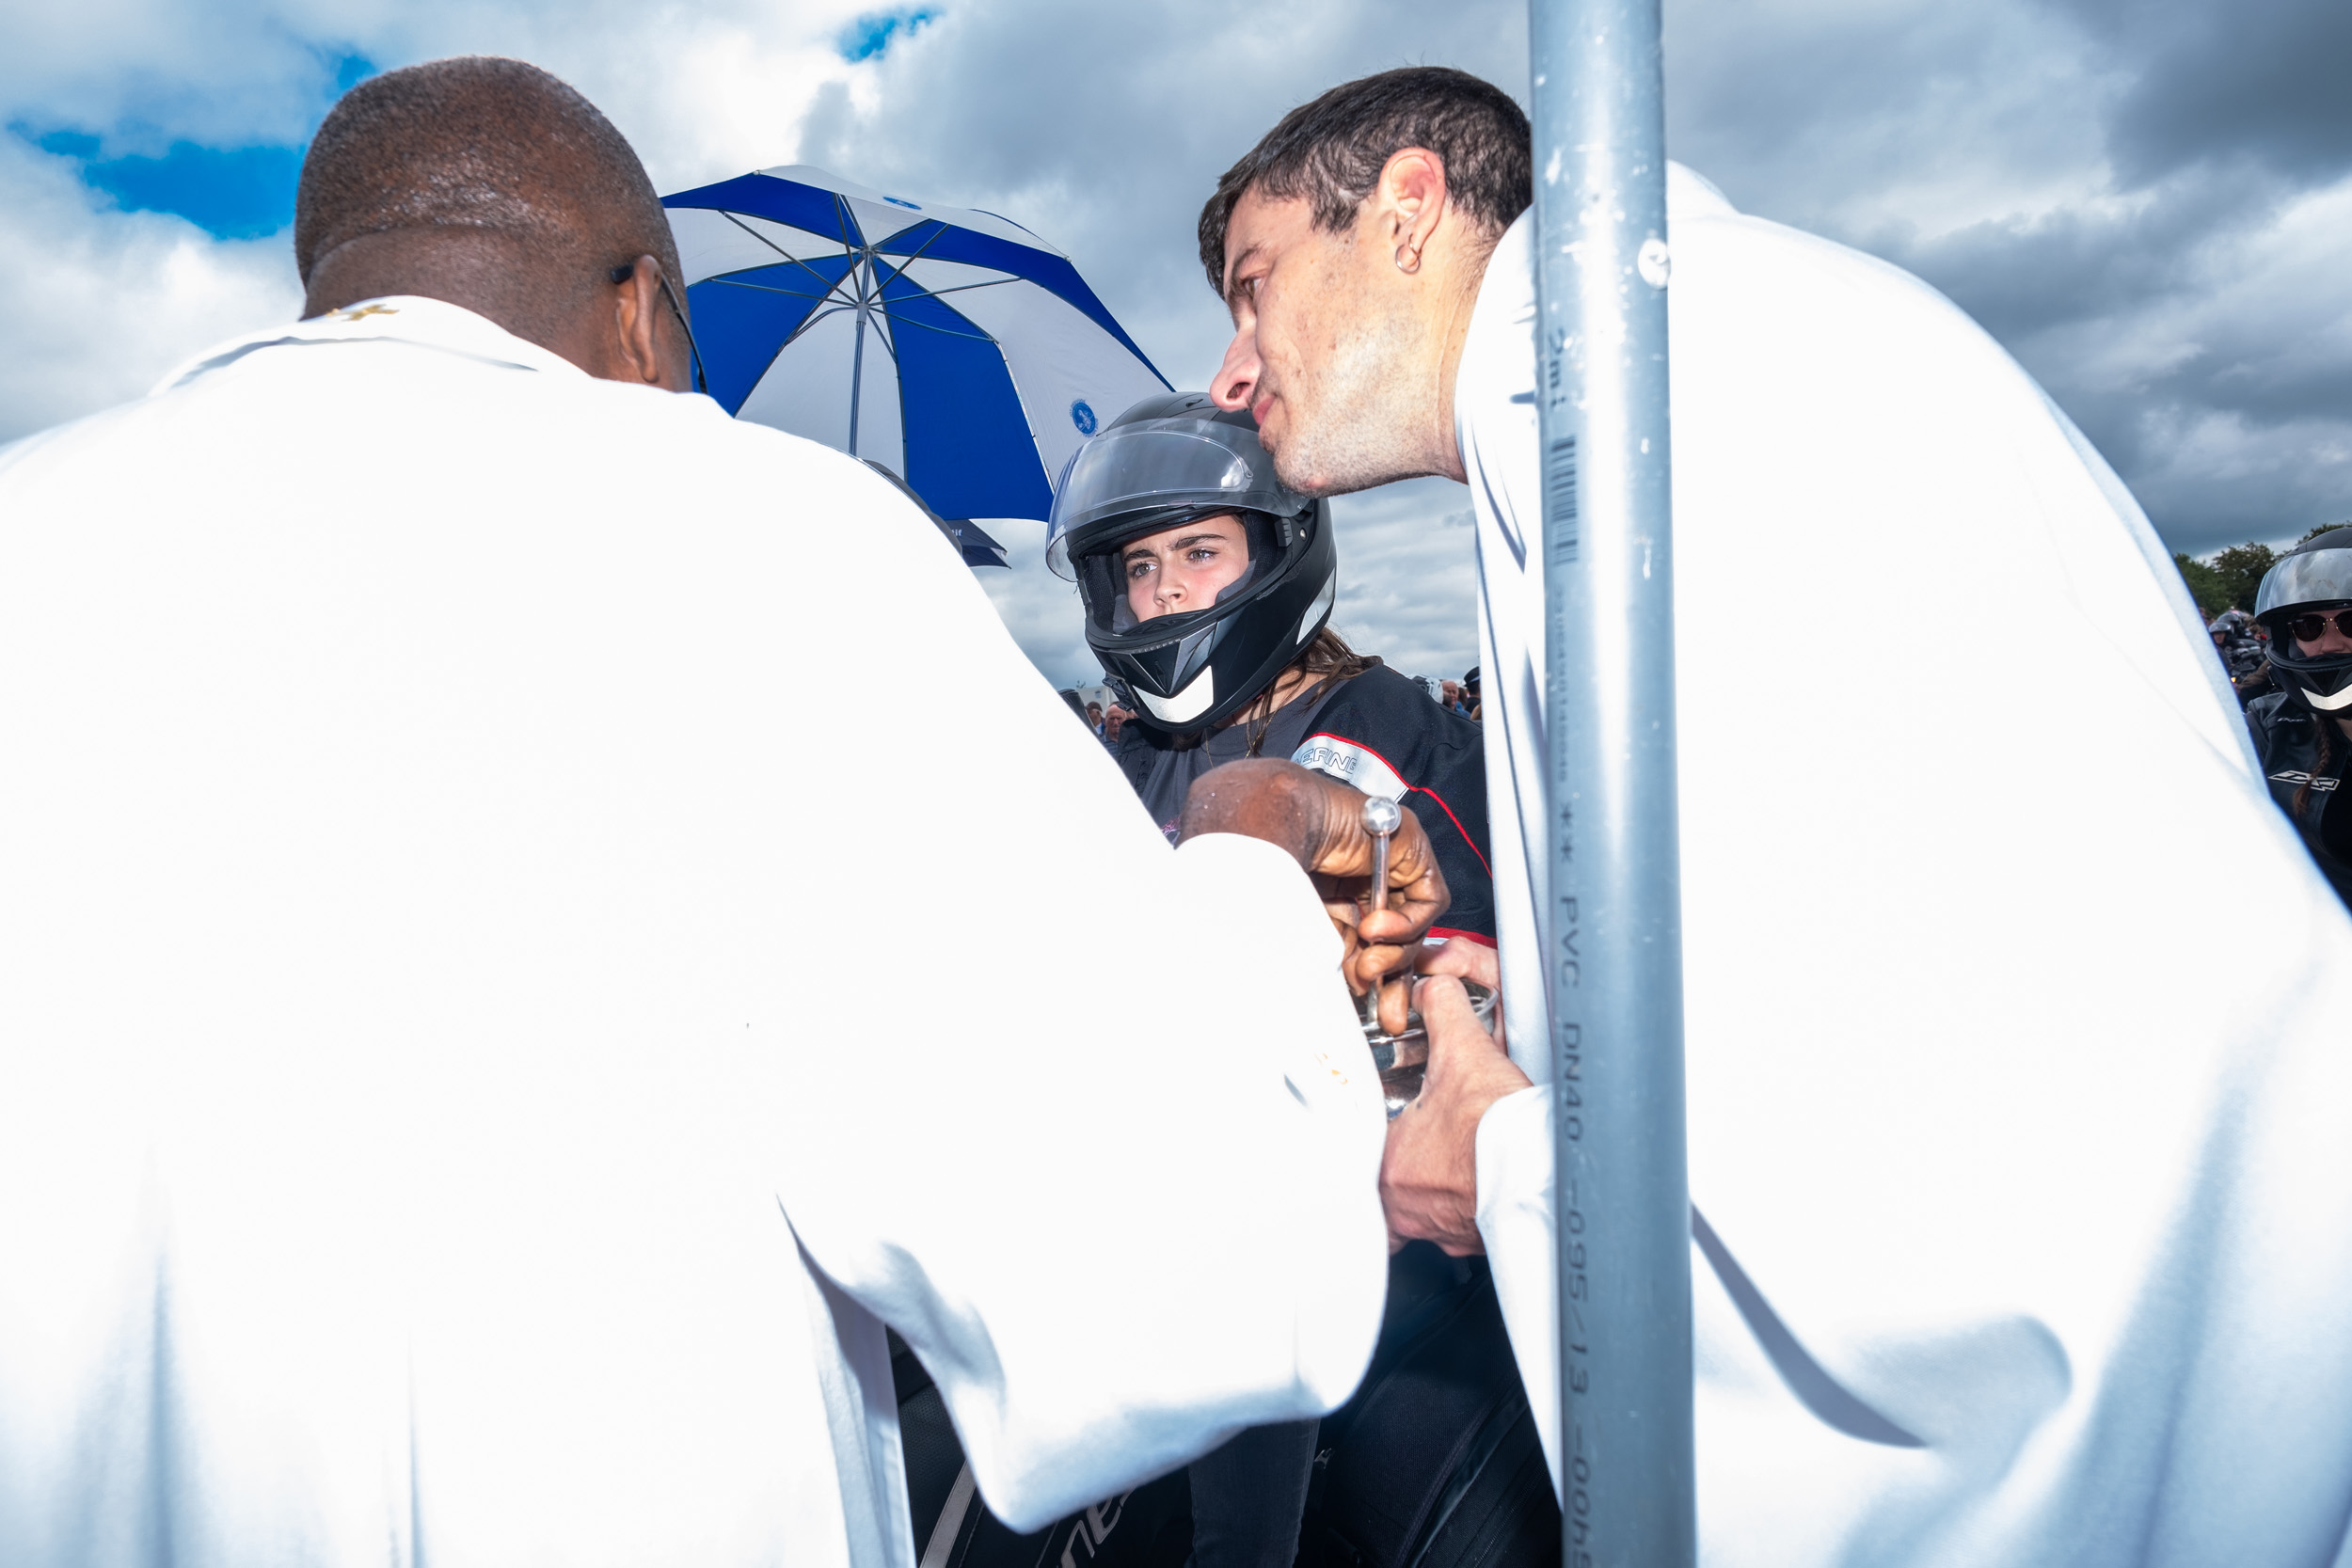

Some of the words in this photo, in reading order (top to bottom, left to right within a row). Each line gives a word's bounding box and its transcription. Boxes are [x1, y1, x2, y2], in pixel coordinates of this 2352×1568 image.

[1295, 747, 1358, 774] ERING
[1561, 896, 1580, 989] PVC
[1563, 1022, 1583, 1145] DN40
